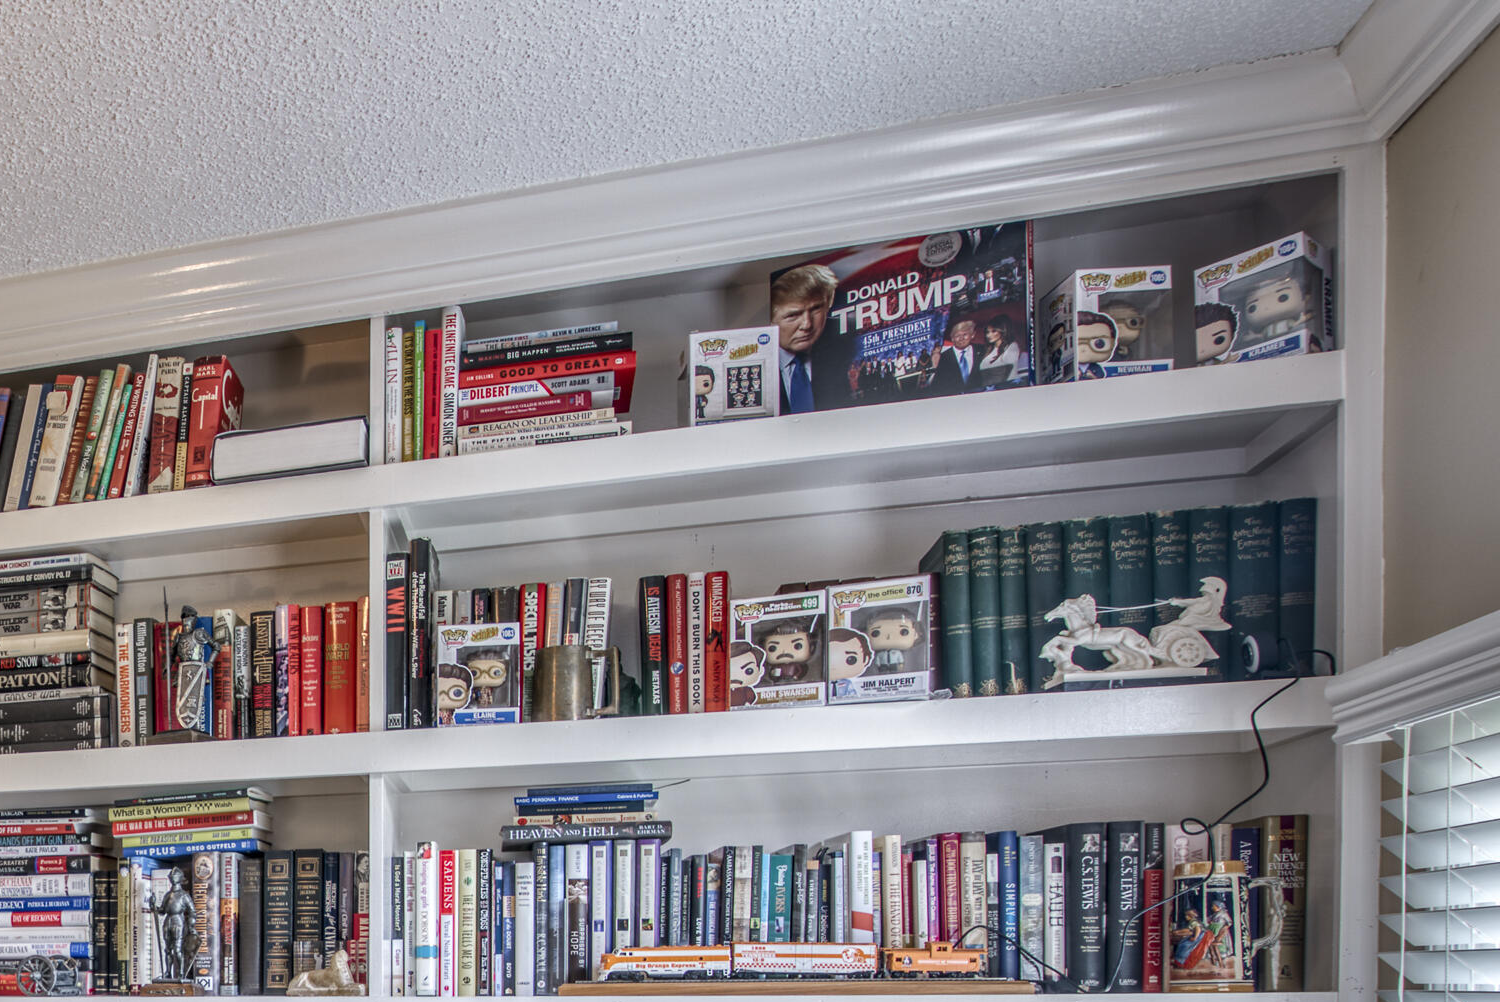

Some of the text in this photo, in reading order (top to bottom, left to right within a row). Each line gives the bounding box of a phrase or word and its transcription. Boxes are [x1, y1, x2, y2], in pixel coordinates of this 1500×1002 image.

[846, 271, 919, 304] DONALD
[831, 274, 968, 335] TRUMP
[1323, 277, 1333, 338] KRAMER
[862, 331, 880, 345] 45th
[882, 318, 932, 341] PRESIDENT
[863, 341, 904, 357] COLLECTOR'S
[906, 334, 931, 347] VAULT
[1249, 341, 1286, 358] KRAMER
[198, 364, 215, 373] KARL
[500, 358, 609, 379] GOOD TO GREAT
[1117, 365, 1152, 374] NEWMAN
[182, 376, 190, 404] CAPTAIN
[123, 375, 143, 437] ON WRITING WELL
[443, 392, 454, 445] SIMON SINEK
[483, 412, 593, 431] REAGAN ON LEADERSHIP
[711, 576, 722, 622] UNMASKED
[867, 587, 905, 600] the office
[906, 584, 922, 596] 870
[3, 601, 21, 610] WAR
[387, 587, 405, 632] WWII
[692, 591, 700, 620] DON'T
[3, 624, 21, 632] WAR
[524, 591, 538, 671] SPECIAL TASKS
[692, 624, 700, 650] BURN
[1, 658, 15, 668] RED
[17, 655, 38, 668] SNOW
[118, 643, 131, 734] THE WARMONGERS
[760, 687, 818, 700] RON SWANSON
[860, 676, 917, 689] JIM HALPERT
[473, 711, 497, 720] ELAINE
[214, 801, 233, 809] Walsh
[19, 837, 33, 845] OFF
[36, 837, 47, 845] MY
[47, 836, 63, 845] GUN
[509, 826, 562, 839] HEAVEN
[582, 826, 619, 837] HELL
[150, 846, 176, 856] PLUS
[206, 843, 236, 851] GUTFELD
[1273, 853, 1300, 862] NEW
[1269, 862, 1306, 870] EVIDENCE
[444, 860, 452, 908] SAPIENS
[1082, 856, 1093, 909] C.S. LEWIS
[1121, 856, 1131, 911] C.S. LEWIS
[1005, 883, 1015, 951] SIMPLY JESUS
[570, 931, 578, 955] HOPE
[1148, 924, 1160, 966] TRUE?
[635, 962, 646, 970] Big
[648, 962, 669, 970] Orange
